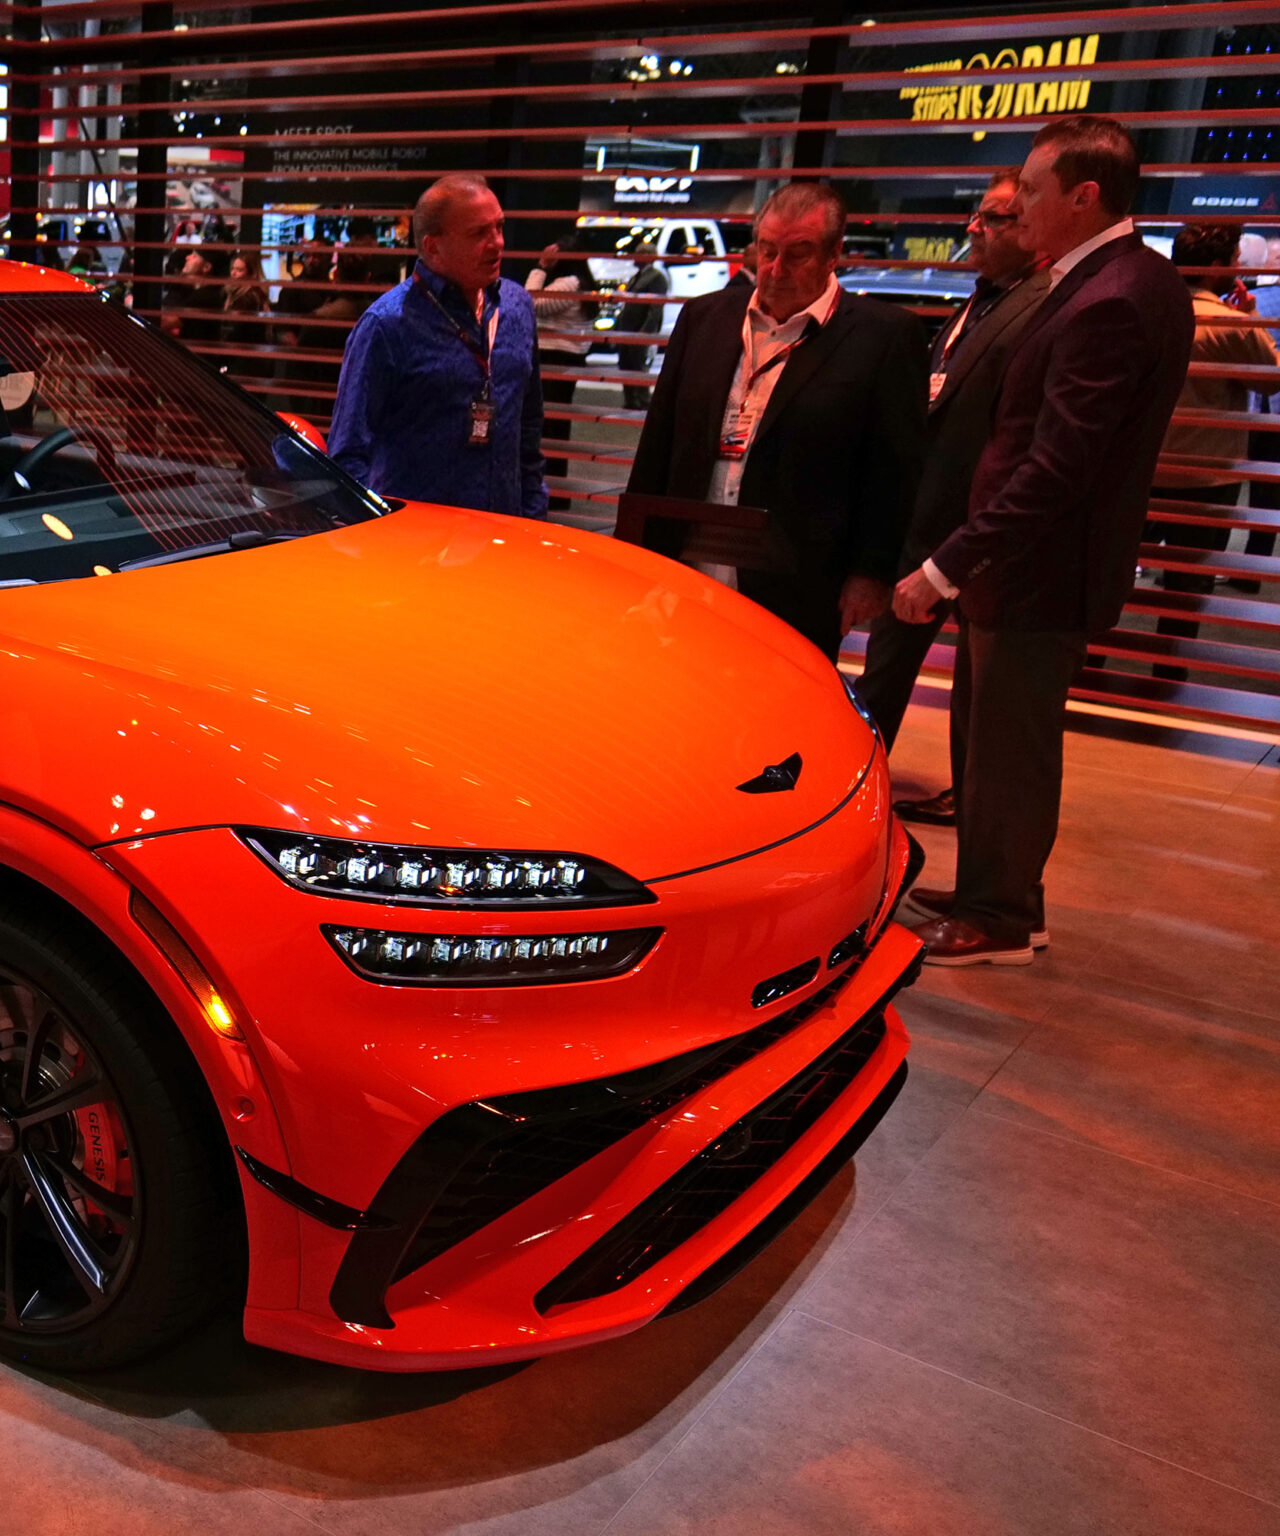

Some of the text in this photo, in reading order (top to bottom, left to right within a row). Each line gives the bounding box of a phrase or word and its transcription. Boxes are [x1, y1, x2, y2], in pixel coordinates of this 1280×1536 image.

[1013, 34, 1099, 116] RAM
[911, 91, 958, 121] STOPS
[273, 148, 427, 160] THE INNOVATIVE MOBILE ROBOT
[1192, 196, 1259, 207] DODGE
[88, 1112, 105, 1181] GENESIS
